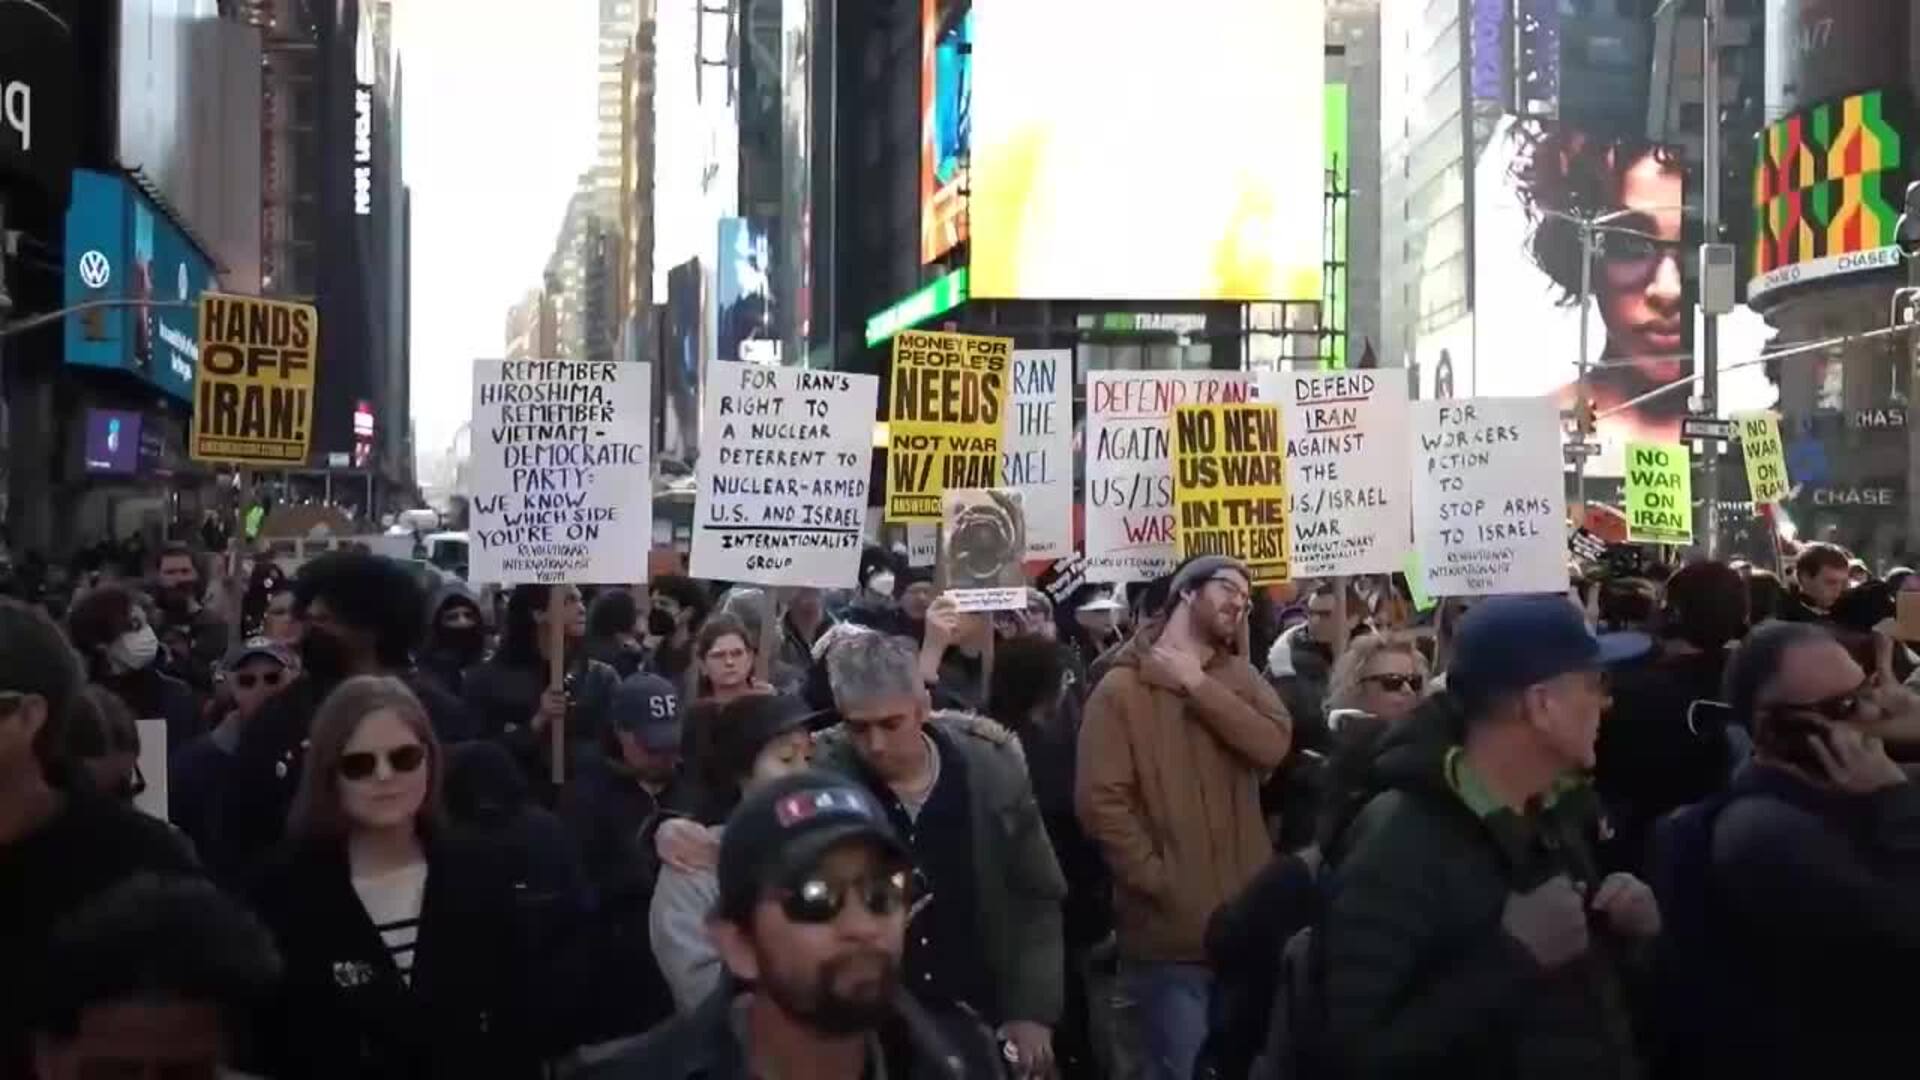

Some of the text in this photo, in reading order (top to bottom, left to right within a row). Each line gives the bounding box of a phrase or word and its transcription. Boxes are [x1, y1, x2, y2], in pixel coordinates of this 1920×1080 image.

[1838, 250, 1888, 270] CHASE
[204, 299, 309, 348] HANDS
[899, 334, 1007, 355] MONEY FOR
[203, 343, 309, 379] OFF
[502, 361, 618, 382] REMEMBER
[897, 350, 1005, 371] PEOPLE'S
[741, 369, 850, 392] FOR IRAN'S
[1013, 358, 1057, 395] RAN
[1296, 375, 1375, 400] DEFEND
[895, 367, 1000, 425] NEEDS
[1094, 378, 1248, 413] DEFEND IRAN
[200, 380, 306, 440] IRAN!
[502, 404, 615, 423] REMEMBER
[720, 396, 829, 418] RIGHT TO
[1439, 405, 1477, 427] FOR
[1016, 401, 1057, 436] THE
[1306, 408, 1357, 429] IRAN
[1746, 420, 1767, 437] NO
[492, 425, 588, 444] VIETNAM
[722, 423, 831, 440] A NUCLEAR
[1176, 408, 1278, 453] NO NEW
[1421, 426, 1519, 451] WORKERS
[893, 435, 997, 451] NOT WAR
[1097, 426, 1170, 461] AGAIN
[1286, 433, 1364, 457] AGAINST
[1746, 439, 1778, 459] WAR
[504, 443, 643, 468] DEMOCRATIC
[719, 447, 857, 467] DETERRENT TO
[1428, 452, 1489, 474] ACTION
[1636, 450, 1669, 467] NO
[893, 452, 996, 492] W/ IRAN
[1001, 450, 1057, 487] RAEL
[1179, 455, 1282, 489] US WAR
[1301, 462, 1338, 482] THE
[1758, 464, 1778, 481] ON
[513, 468, 595, 493] PARTY:
[712, 475, 865, 498] NUCLEAR-ARMED
[1091, 472, 1175, 510] US/IS
[1440, 477, 1464, 492] TO
[1631, 470, 1681, 490] WAR
[1756, 480, 1784, 498] IRAN
[474, 492, 588, 514] WE KNOW
[1644, 492, 1675, 509] ON
[1813, 488, 1892, 505] CHASE
[503, 507, 619, 527] WHICH SIDE
[711, 504, 862, 526] U.S. AND ISRAEL
[1181, 498, 1284, 528] IN THE
[1439, 498, 1551, 520] STOP ARMS
[1634, 509, 1683, 529] IRAN
[478, 524, 599, 550] YOU'RE ON
[1123, 515, 1176, 543] WAR
[1296, 519, 1341, 541] WAR
[1440, 521, 1540, 547] TO ISRAEL
[722, 533, 859, 549] INTERNATIONALIST
[1183, 527, 1285, 560] MIDDLE EAST
[746, 555, 793, 570] GROUP
